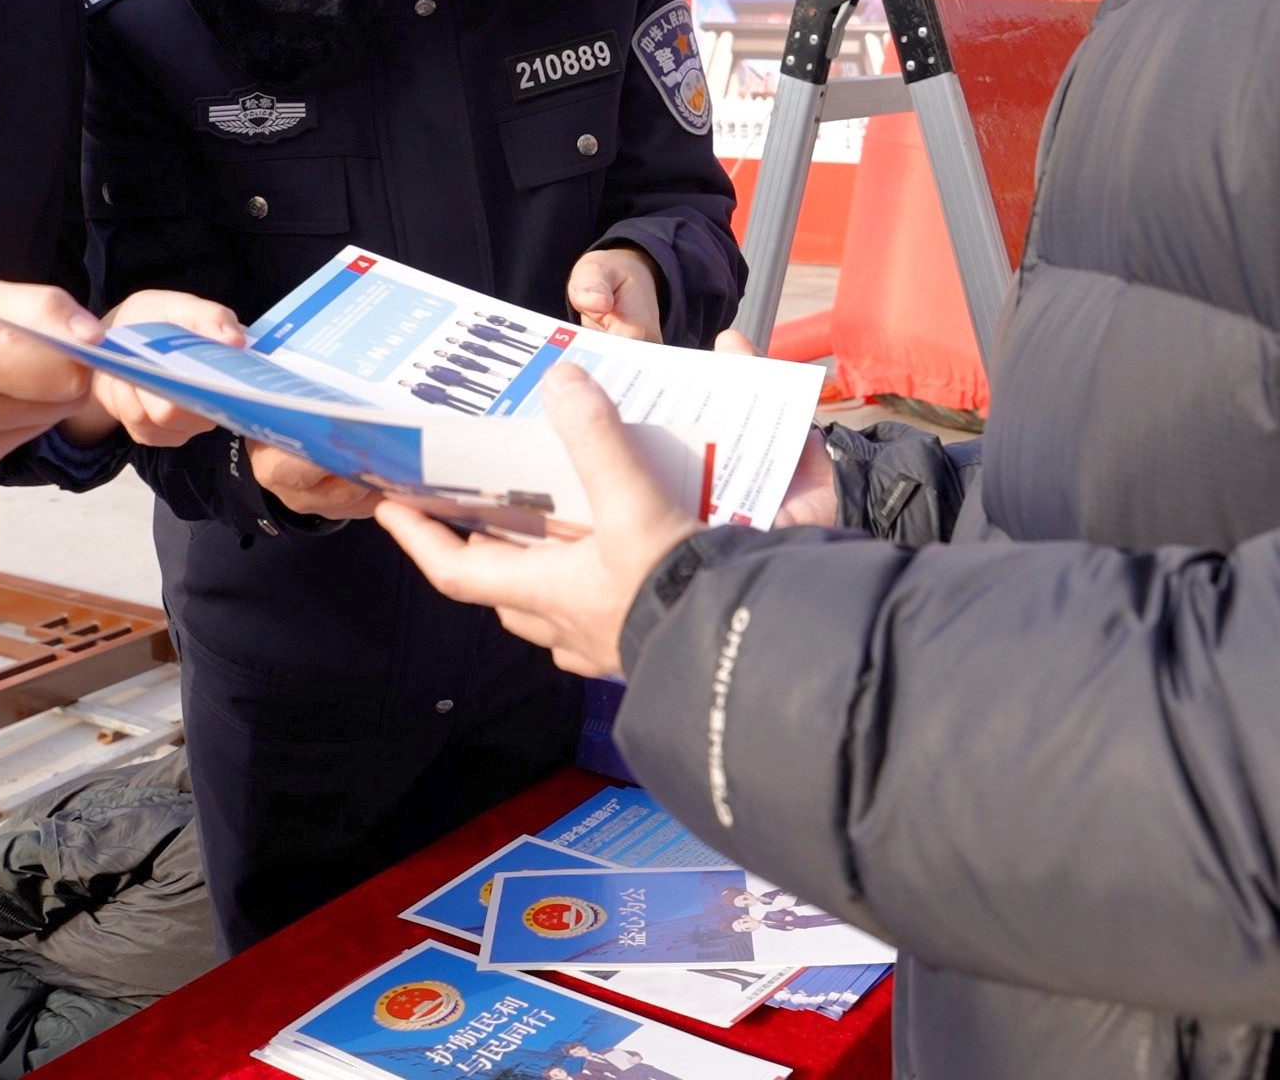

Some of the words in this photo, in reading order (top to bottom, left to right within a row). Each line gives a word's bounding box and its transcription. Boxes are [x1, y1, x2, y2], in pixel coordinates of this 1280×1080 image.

[513, 39, 612, 91] 210889
[618, 887, 647, 948] 益心为公
[425, 996, 530, 1066] 护航民利
[456, 1008, 556, 1078] 与民同行
